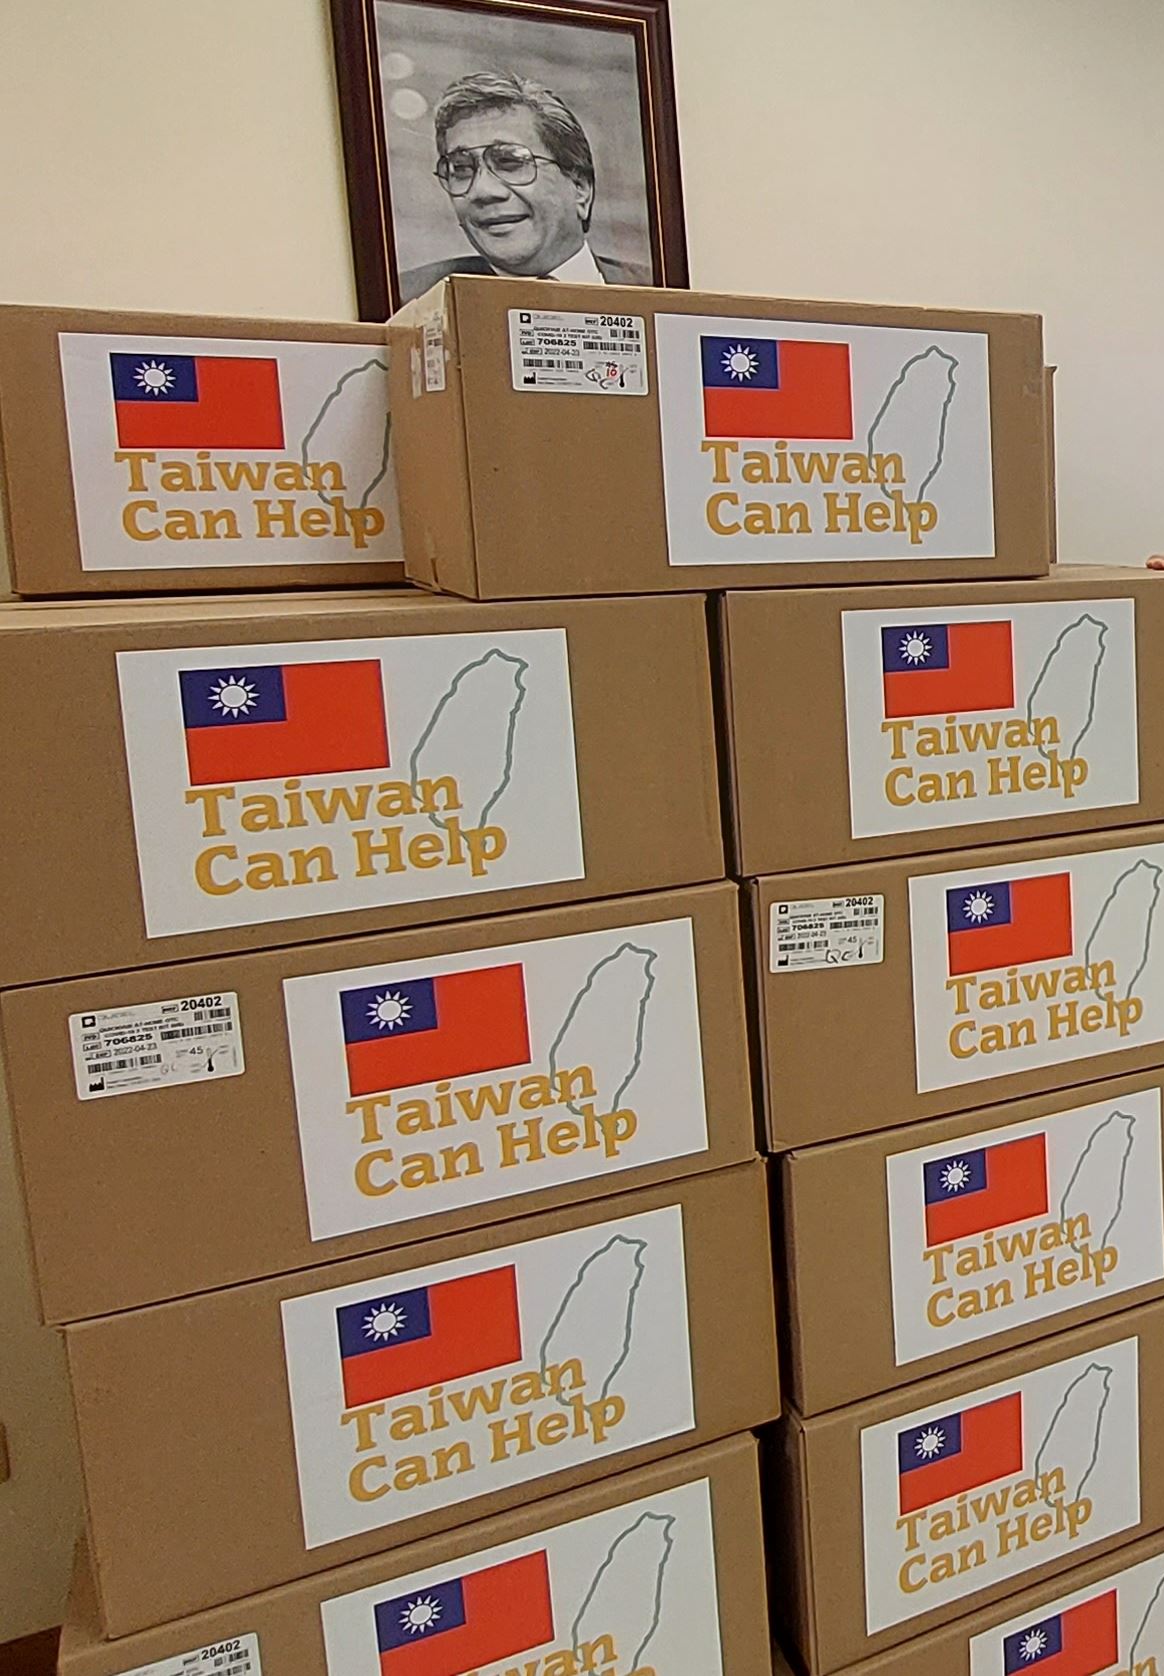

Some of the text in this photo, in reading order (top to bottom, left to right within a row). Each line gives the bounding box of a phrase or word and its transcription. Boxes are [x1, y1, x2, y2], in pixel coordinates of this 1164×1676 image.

[537, 338, 577, 346] 706825
[600, 316, 633, 327] 20402
[113, 451, 344, 493] Taiwan
[701, 440, 904, 484] Taiwan
[122, 496, 385, 551] Can Help
[705, 491, 937, 544] Can Help
[881, 714, 1060, 759] Taiwan
[884, 751, 1088, 806] Can Help
[184, 776, 461, 837] Taiwan
[194, 816, 506, 896] Can Help
[845, 896, 874, 907] 20402
[180, 996, 222, 1012] 20402
[944, 960, 1116, 1014] Taiwan
[104, 1034, 153, 1046] 706825
[189, 1046, 204, 1055] 45
[948, 992, 1142, 1058] Can Help
[346, 1065, 597, 1144] Taiwan
[355, 1104, 637, 1199] Can Help
[923, 1213, 1091, 1284] Taiwan
[927, 1245, 1118, 1328] Can Help
[341, 1358, 584, 1451] Taiwan
[349, 1394, 625, 1501] Can Help
[896, 1468, 1065, 1552] Taiwan
[898, 1500, 1092, 1594] Can Help
[201, 1640, 241, 1660] 20402
